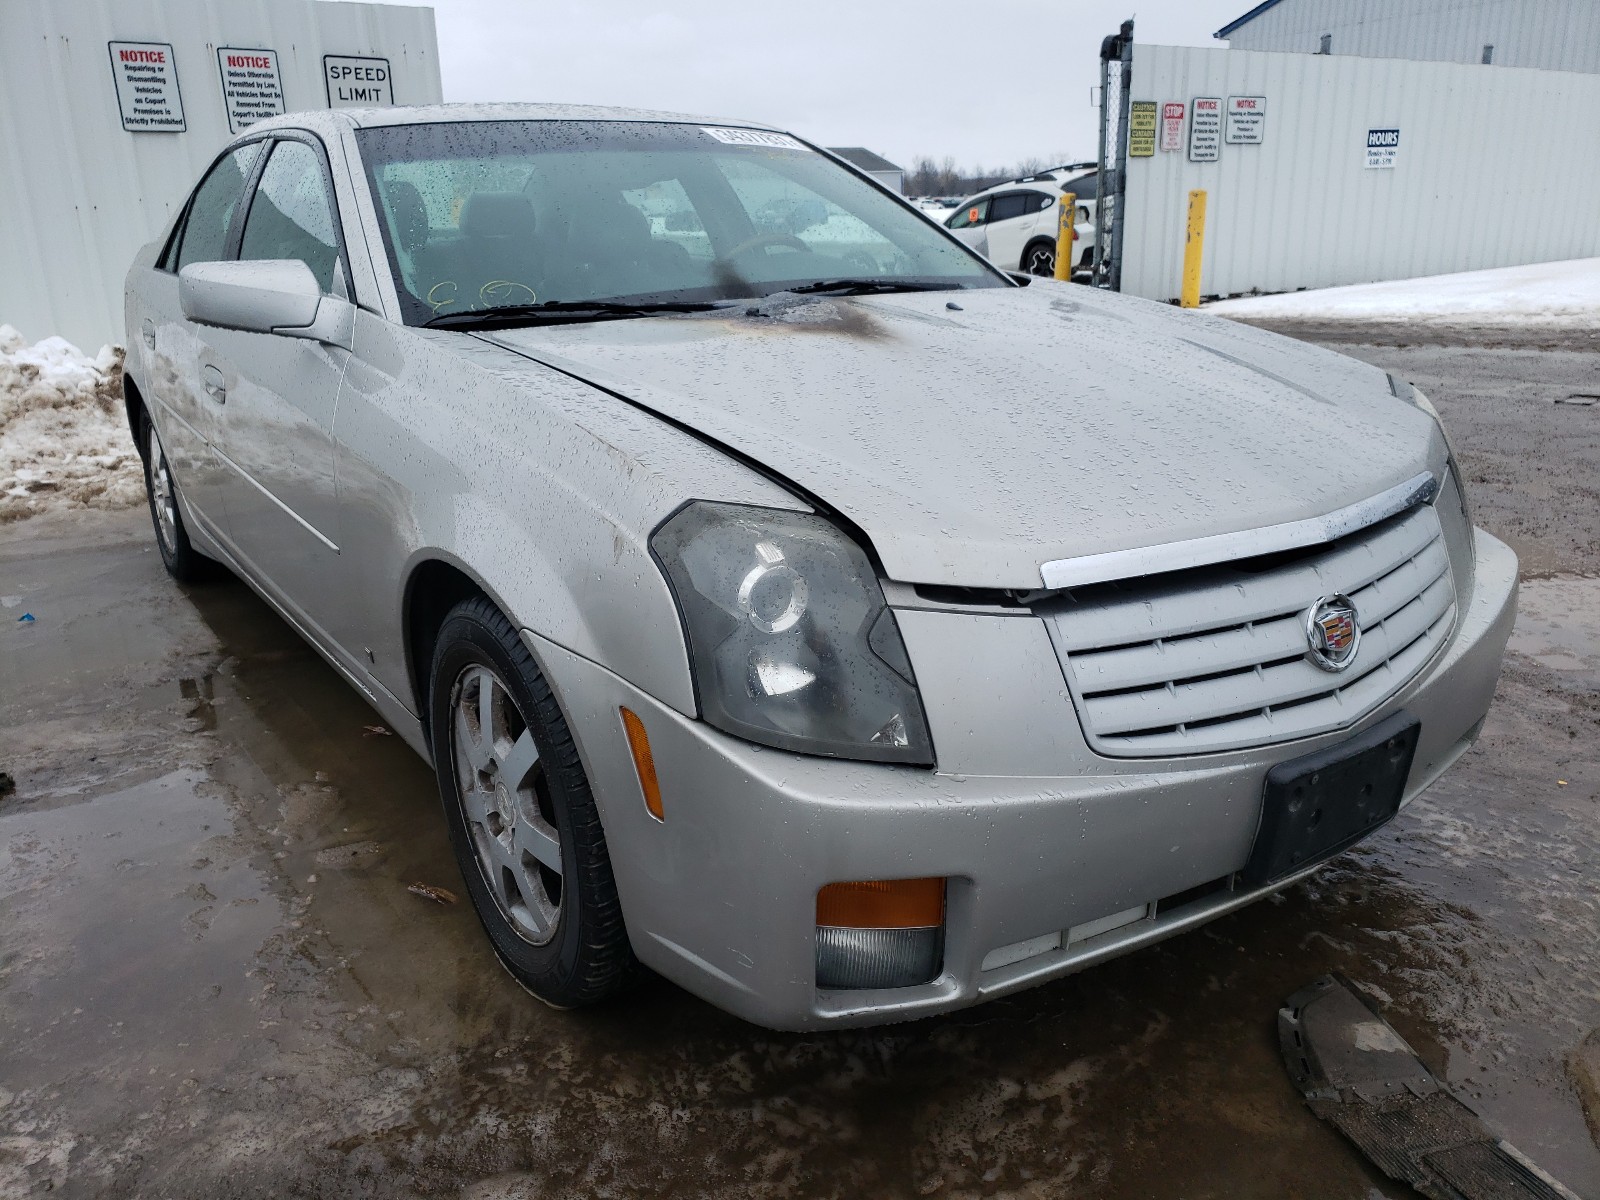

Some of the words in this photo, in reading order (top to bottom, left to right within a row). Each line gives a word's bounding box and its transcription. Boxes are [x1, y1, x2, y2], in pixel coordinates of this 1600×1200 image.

[120, 50, 165, 63] NOTICE
[227, 55, 271, 69] NOTICE
[124, 64, 156, 73] Repairing
[228, 70, 246, 78] Unless
[247, 71, 275, 79] Otherwise
[330, 66, 386, 81] SPEED
[127, 75, 166, 84] Dismantling
[228, 80, 255, 88] Permitted
[256, 82, 263, 90] by
[264, 82, 277, 90] Law,
[135, 86, 162, 94] Vehicles
[338, 87, 381, 102] LIMIT
[144, 97, 166, 105] Copart
[1197, 101, 1217, 109] NOTICE
[1236, 100, 1256, 108] NOTICE
[133, 107, 164, 115] Premises
[1165, 105, 1183, 117] STOP
[125, 117, 149, 125] Strictly
[1368, 132, 1398, 145] HOURS
